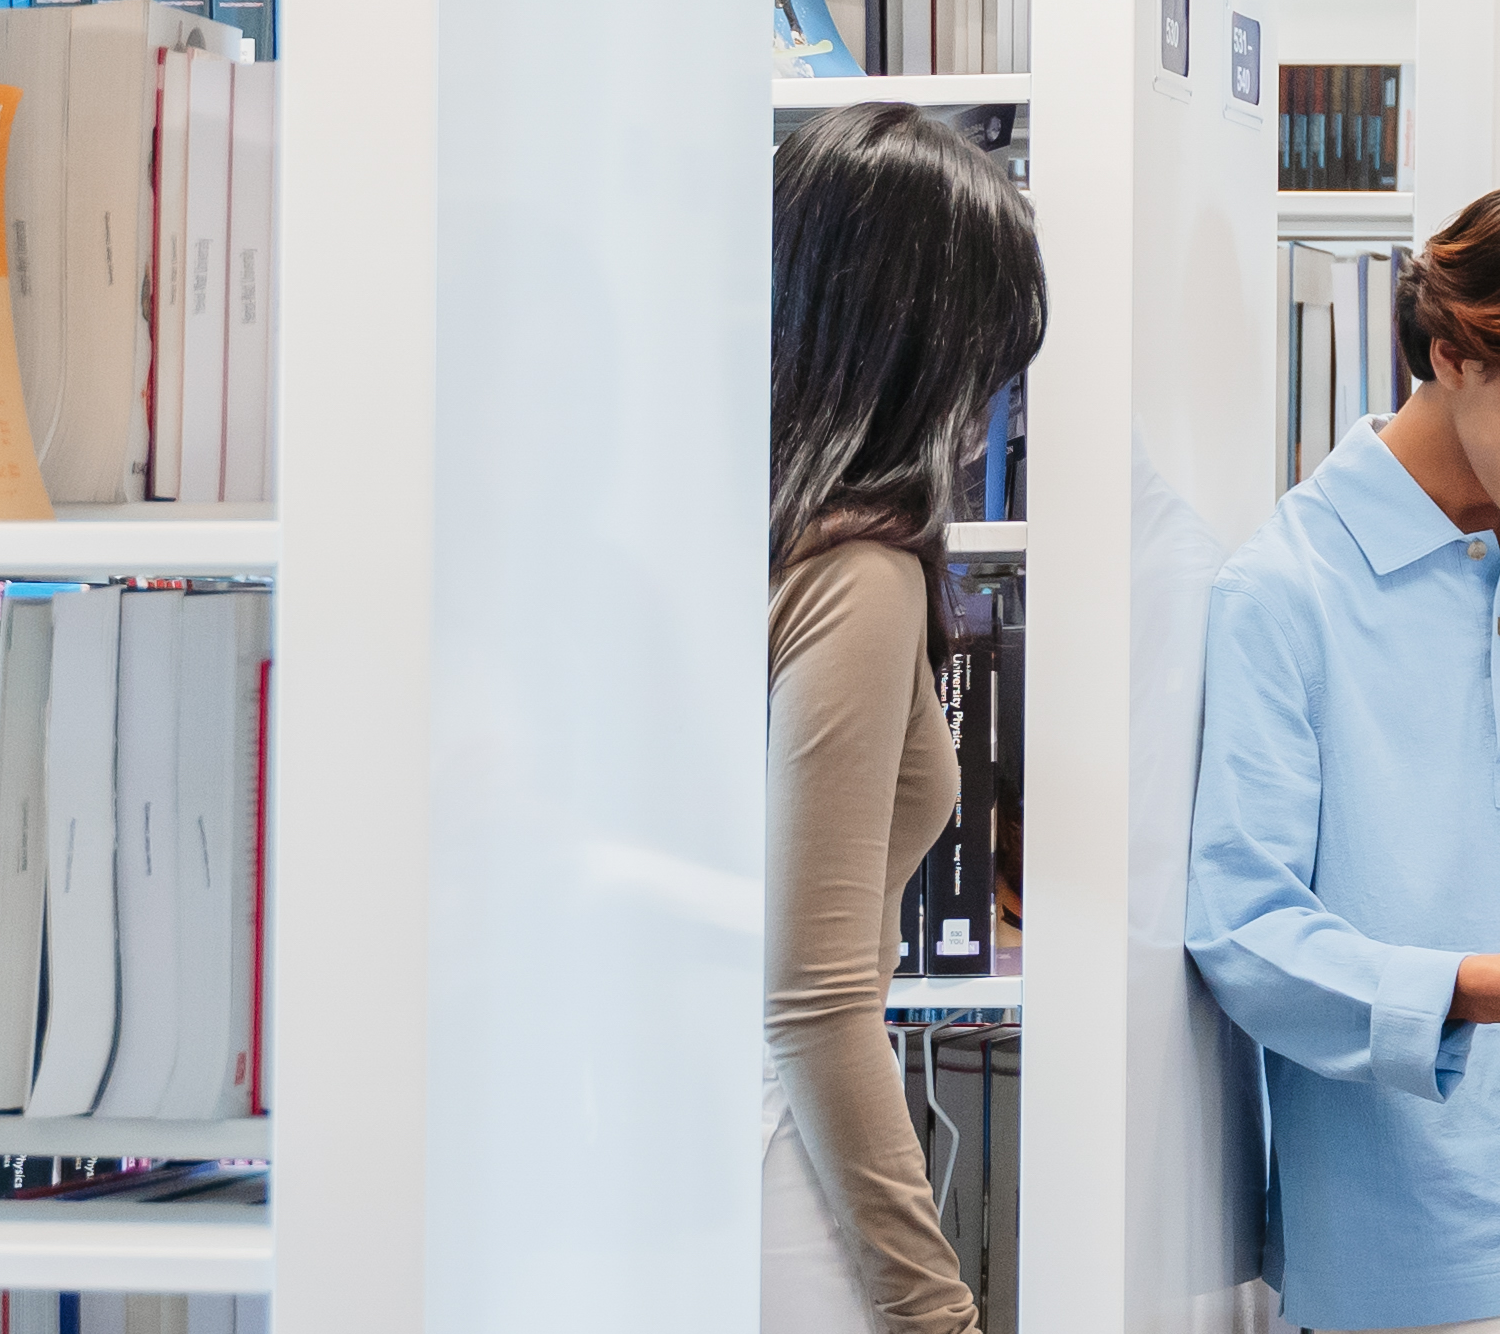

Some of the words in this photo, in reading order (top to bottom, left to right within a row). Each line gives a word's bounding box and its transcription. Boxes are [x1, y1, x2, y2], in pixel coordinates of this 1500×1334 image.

[1165, 17, 1179, 48] 530
[1237, 65, 1251, 95] 540
[949, 653, 964, 710] University
[949, 711, 964, 750] Physics
